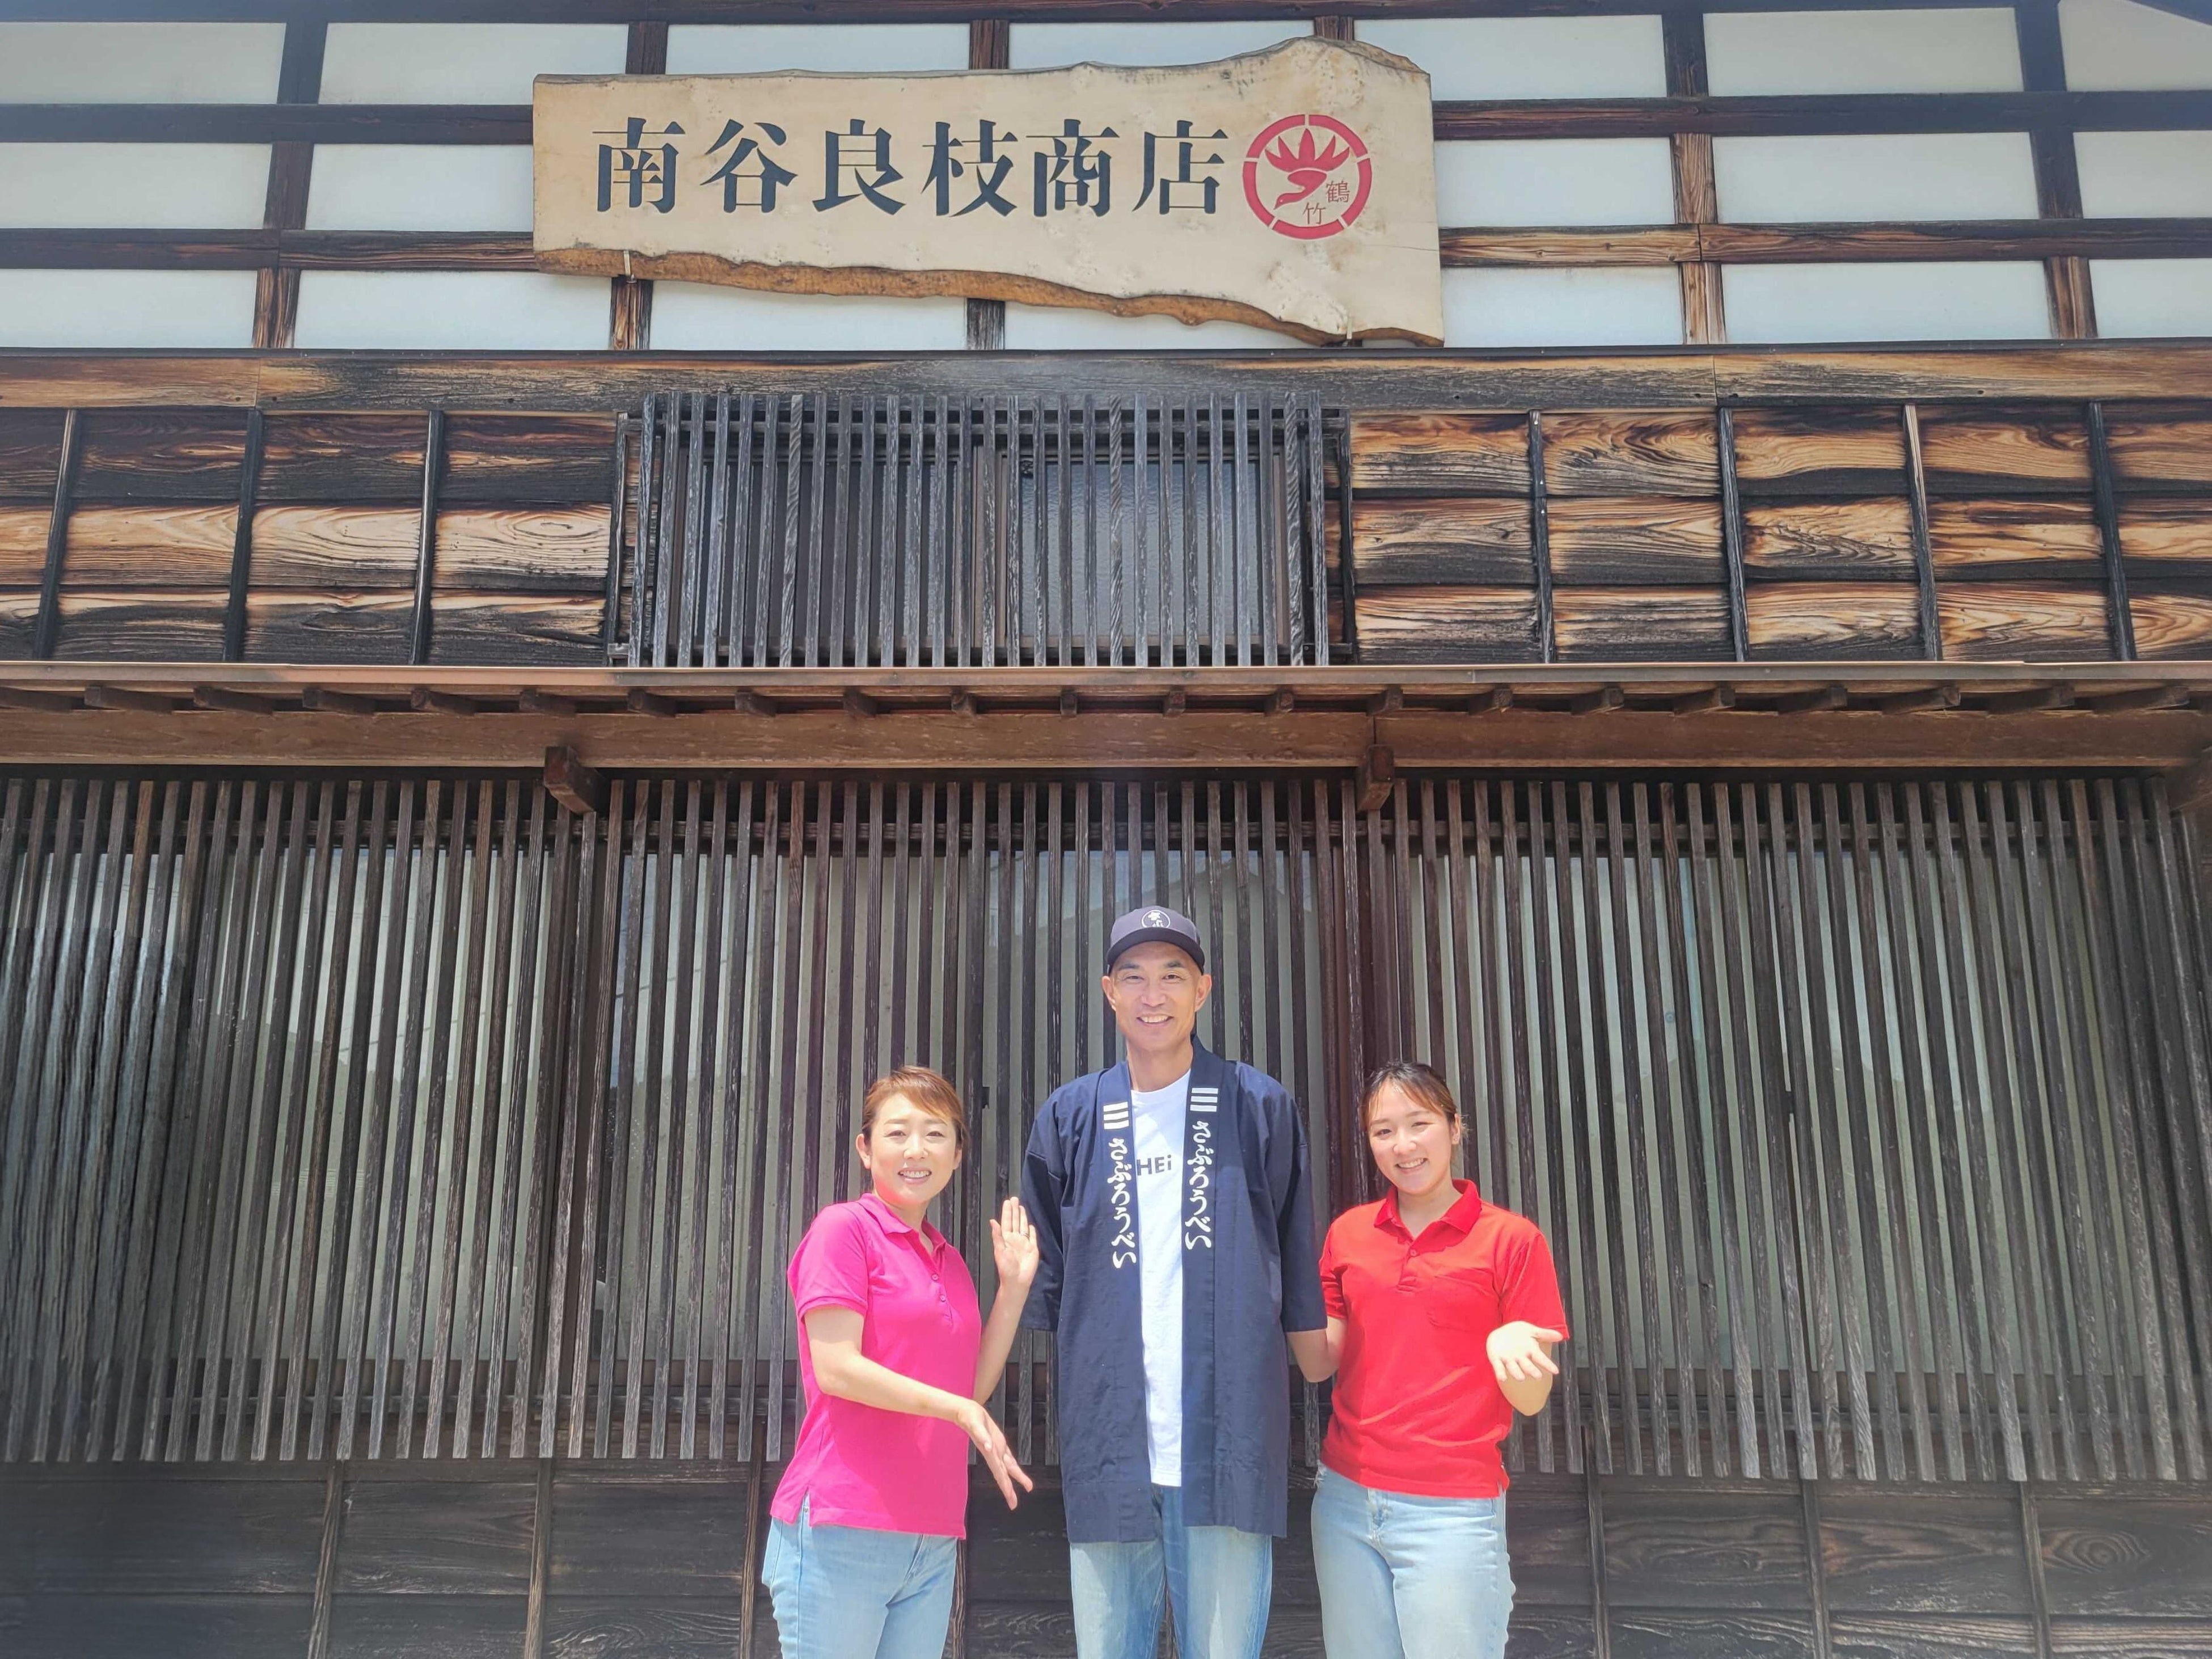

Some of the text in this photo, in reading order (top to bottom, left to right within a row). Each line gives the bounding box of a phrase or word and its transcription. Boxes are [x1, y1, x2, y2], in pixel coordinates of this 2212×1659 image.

[592, 117, 1229, 218] 南谷良枝商店
[1303, 202, 1326, 225] 竹
[1325, 180, 1350, 203] 鶴
[1107, 1138, 1137, 1269] さぶろうべい
[1185, 1120, 1214, 1249] さぶろうべい
